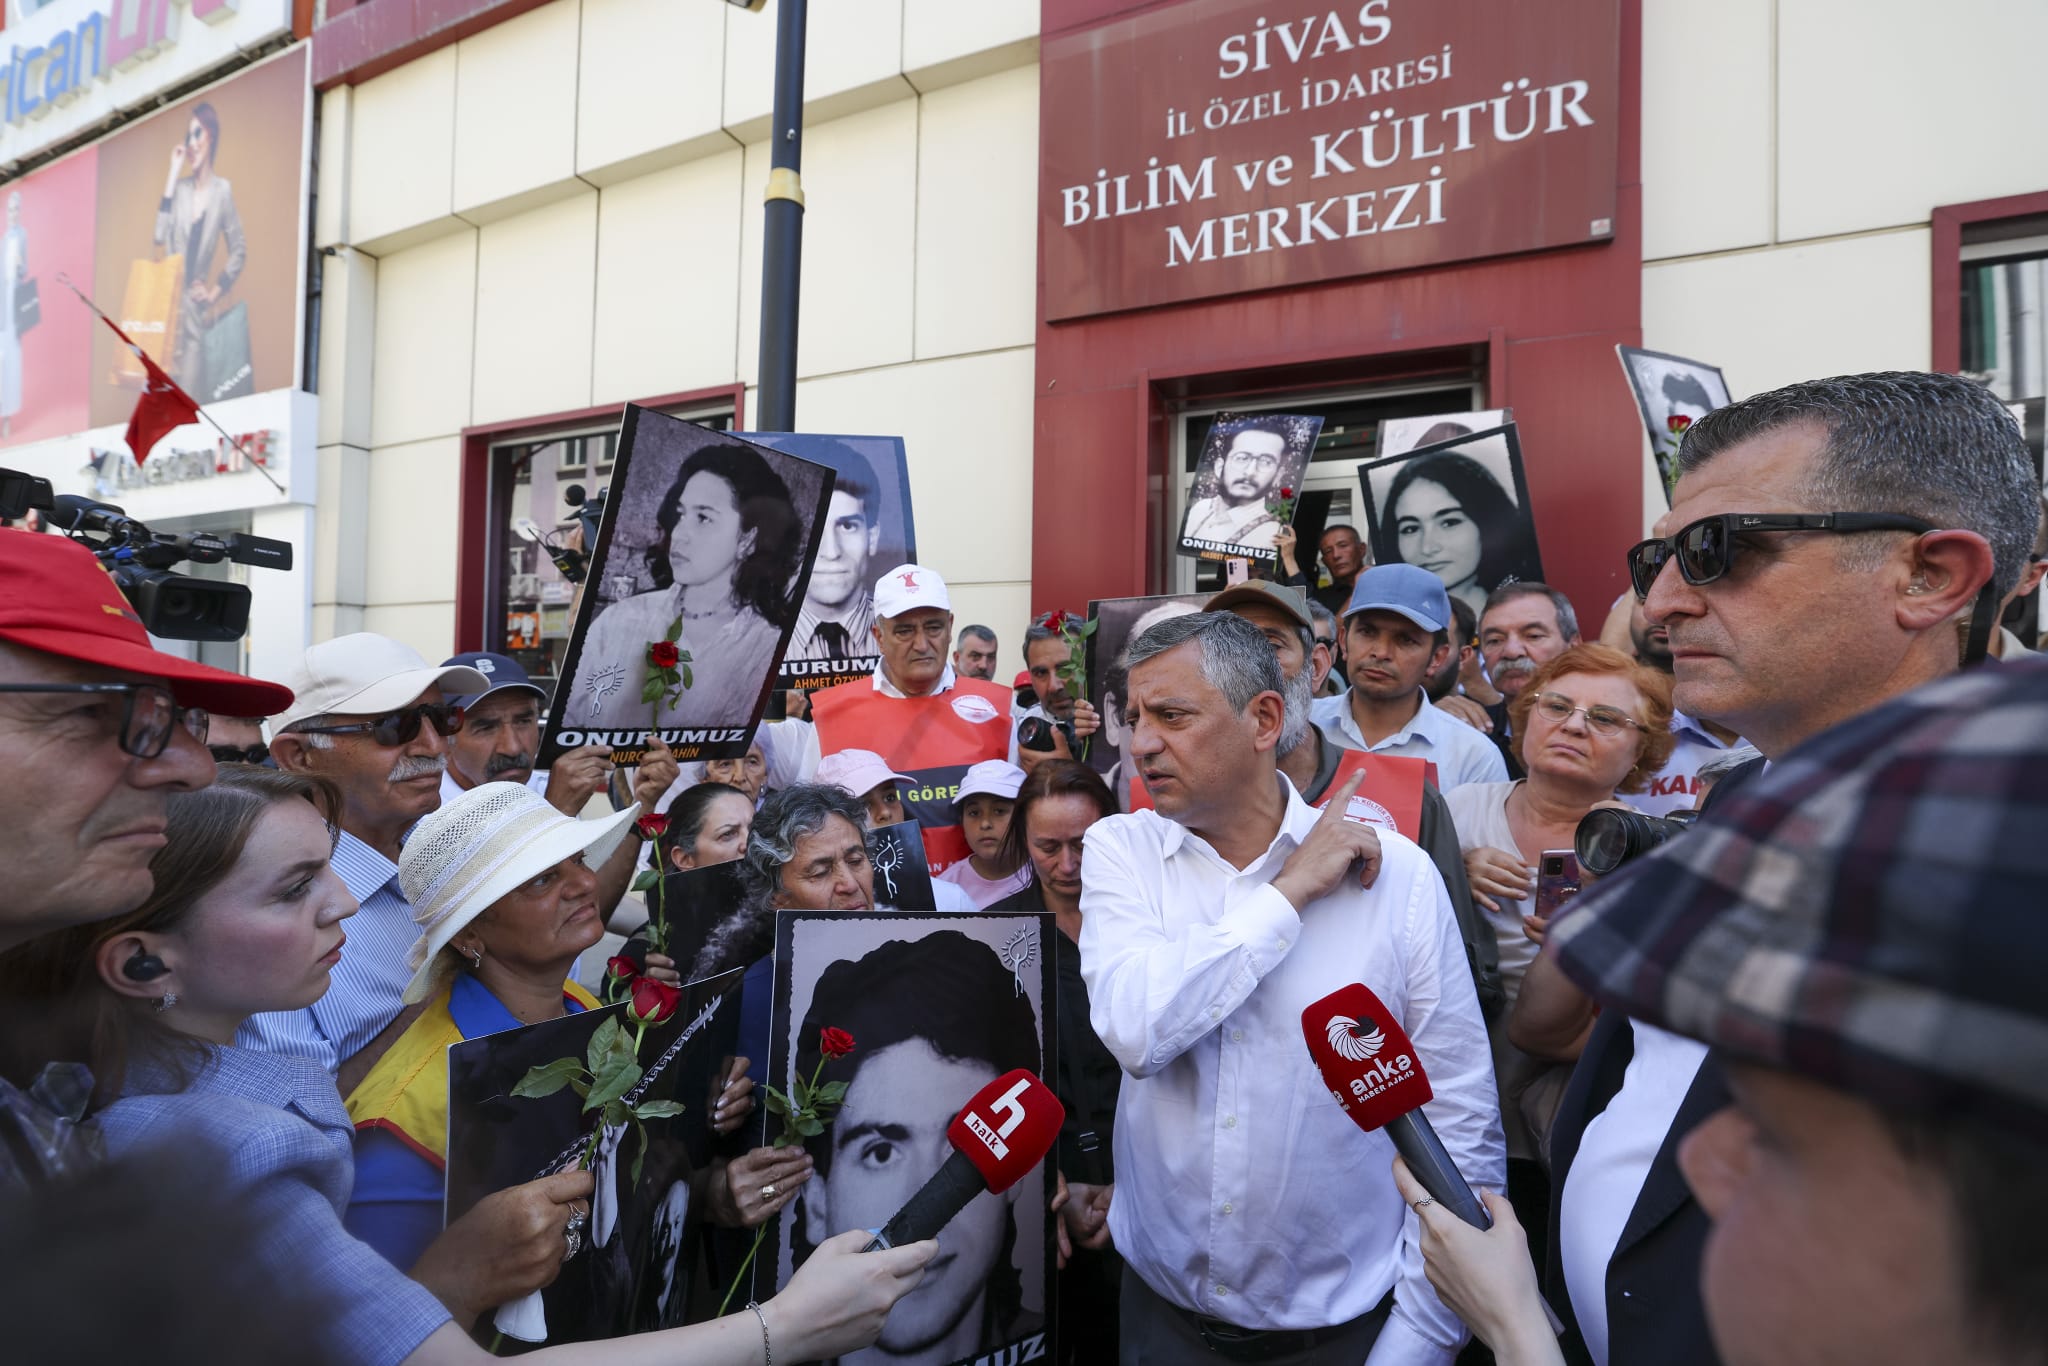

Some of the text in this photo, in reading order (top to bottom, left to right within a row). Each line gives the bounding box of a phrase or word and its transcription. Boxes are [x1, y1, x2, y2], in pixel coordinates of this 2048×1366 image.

[1218, 0, 1393, 80] SİVAS
[1166, 44, 1453, 139] İL ÖZEL İDARESİ
[1061, 77, 1595, 227] BİLİM ve KÜLTÜR
[1165, 165, 1447, 268] MERKEZİ
[1182, 538, 1278, 560] ONURUMUZ
[794, 676, 830, 689] AHMET
[672, 744, 700, 759] AHİN
[1349, 1054, 1412, 1097] anka
[1357, 1084, 1387, 1104] HABER
[970, 1118, 999, 1150] halk
